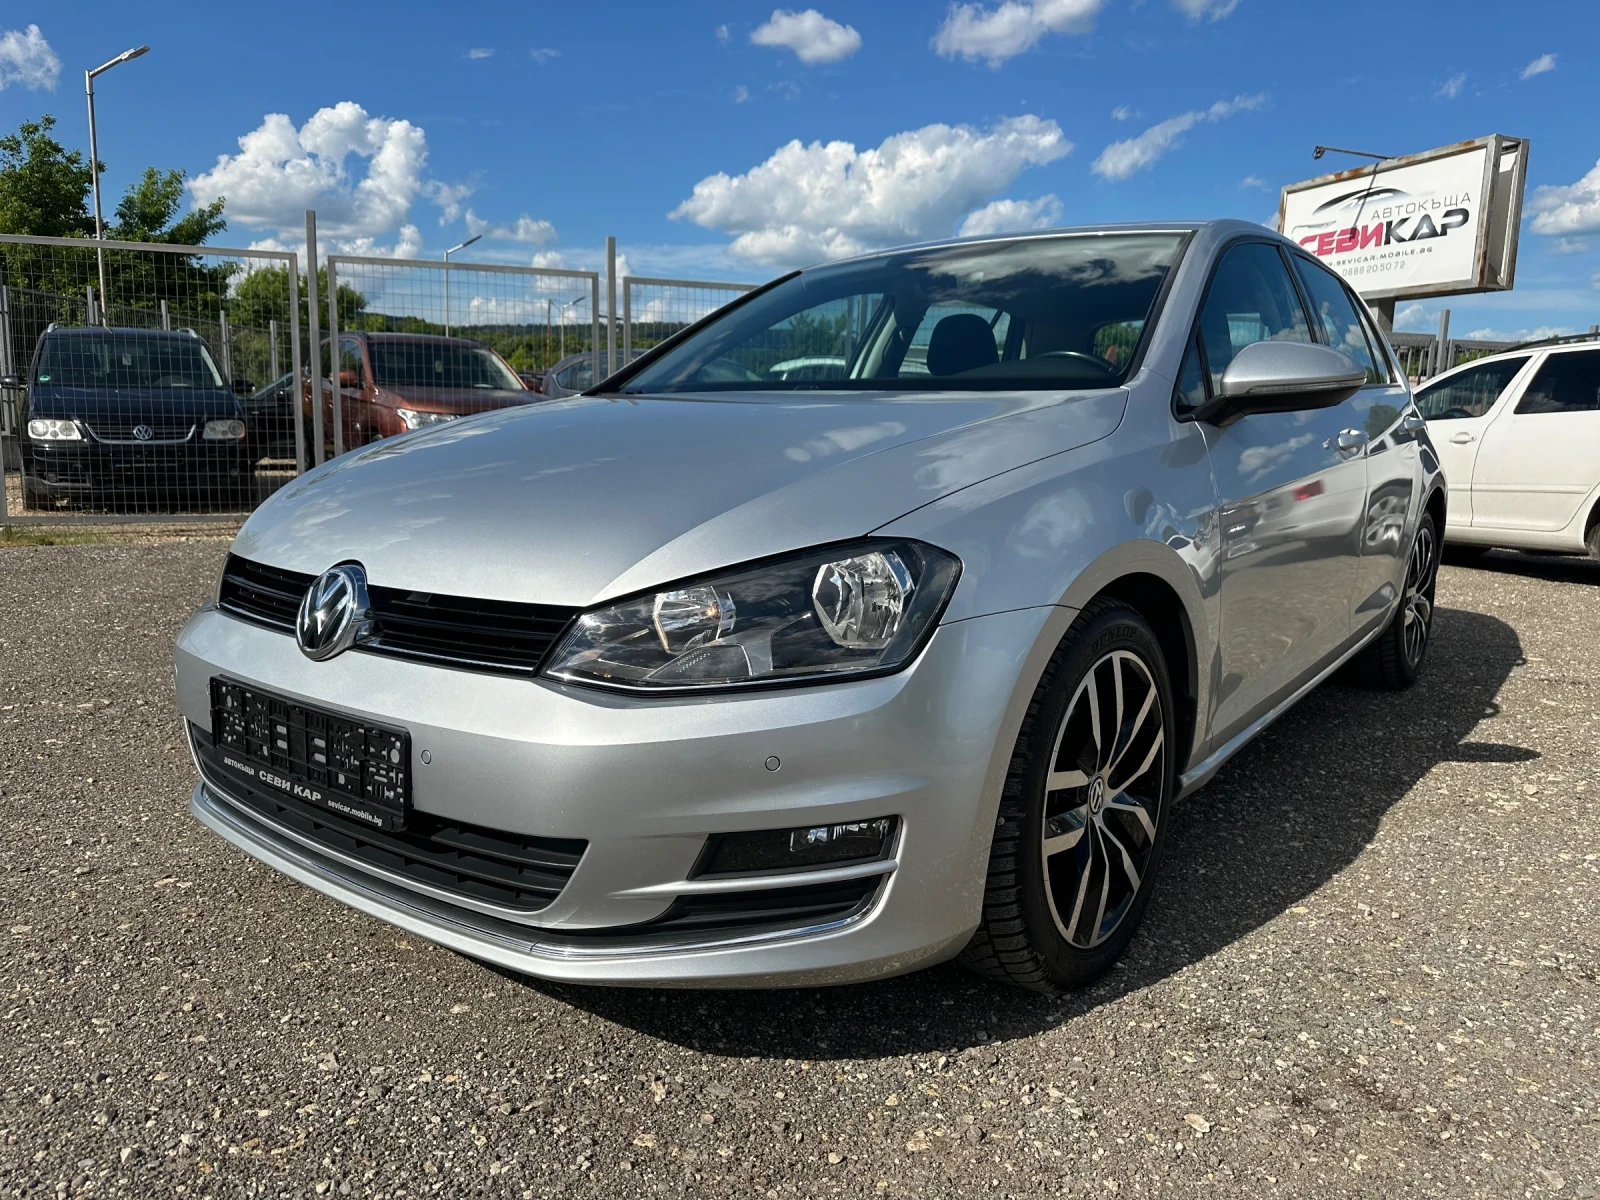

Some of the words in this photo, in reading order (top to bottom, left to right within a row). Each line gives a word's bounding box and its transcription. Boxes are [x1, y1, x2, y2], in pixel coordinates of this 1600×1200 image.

[1371, 192, 1471, 220] АВТОКЪЩА
[1091, 626, 1138, 654] DUNLOP
[258, 770, 291, 791] СЕВИ
[293, 784, 322, 801] КАР
[327, 799, 382, 827] sevicar.mobile.bg
